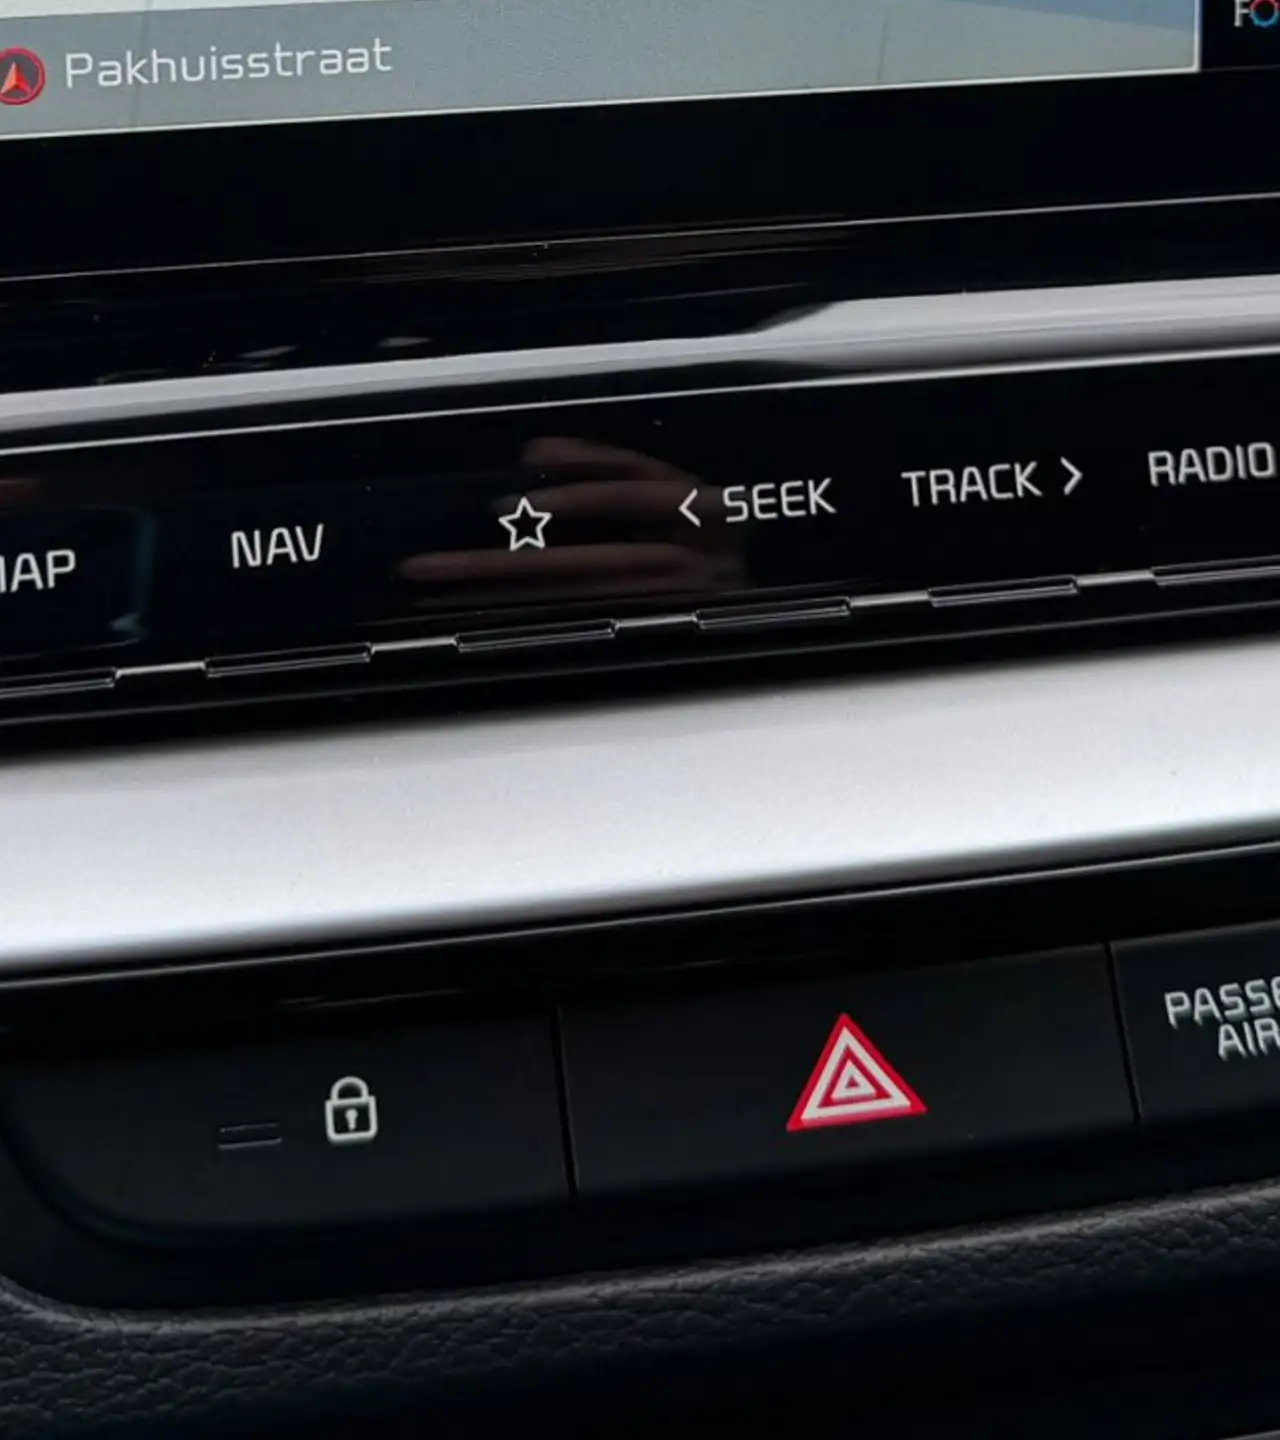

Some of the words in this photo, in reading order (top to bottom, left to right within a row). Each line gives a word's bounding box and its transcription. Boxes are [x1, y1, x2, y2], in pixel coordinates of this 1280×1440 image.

[64, 37, 393, 90] Pakhuisstraat
[902, 461, 1043, 509] TRACK
[1146, 441, 1278, 488] RADIO
[721, 477, 837, 524] SEEK
[230, 523, 325, 570] NAV
